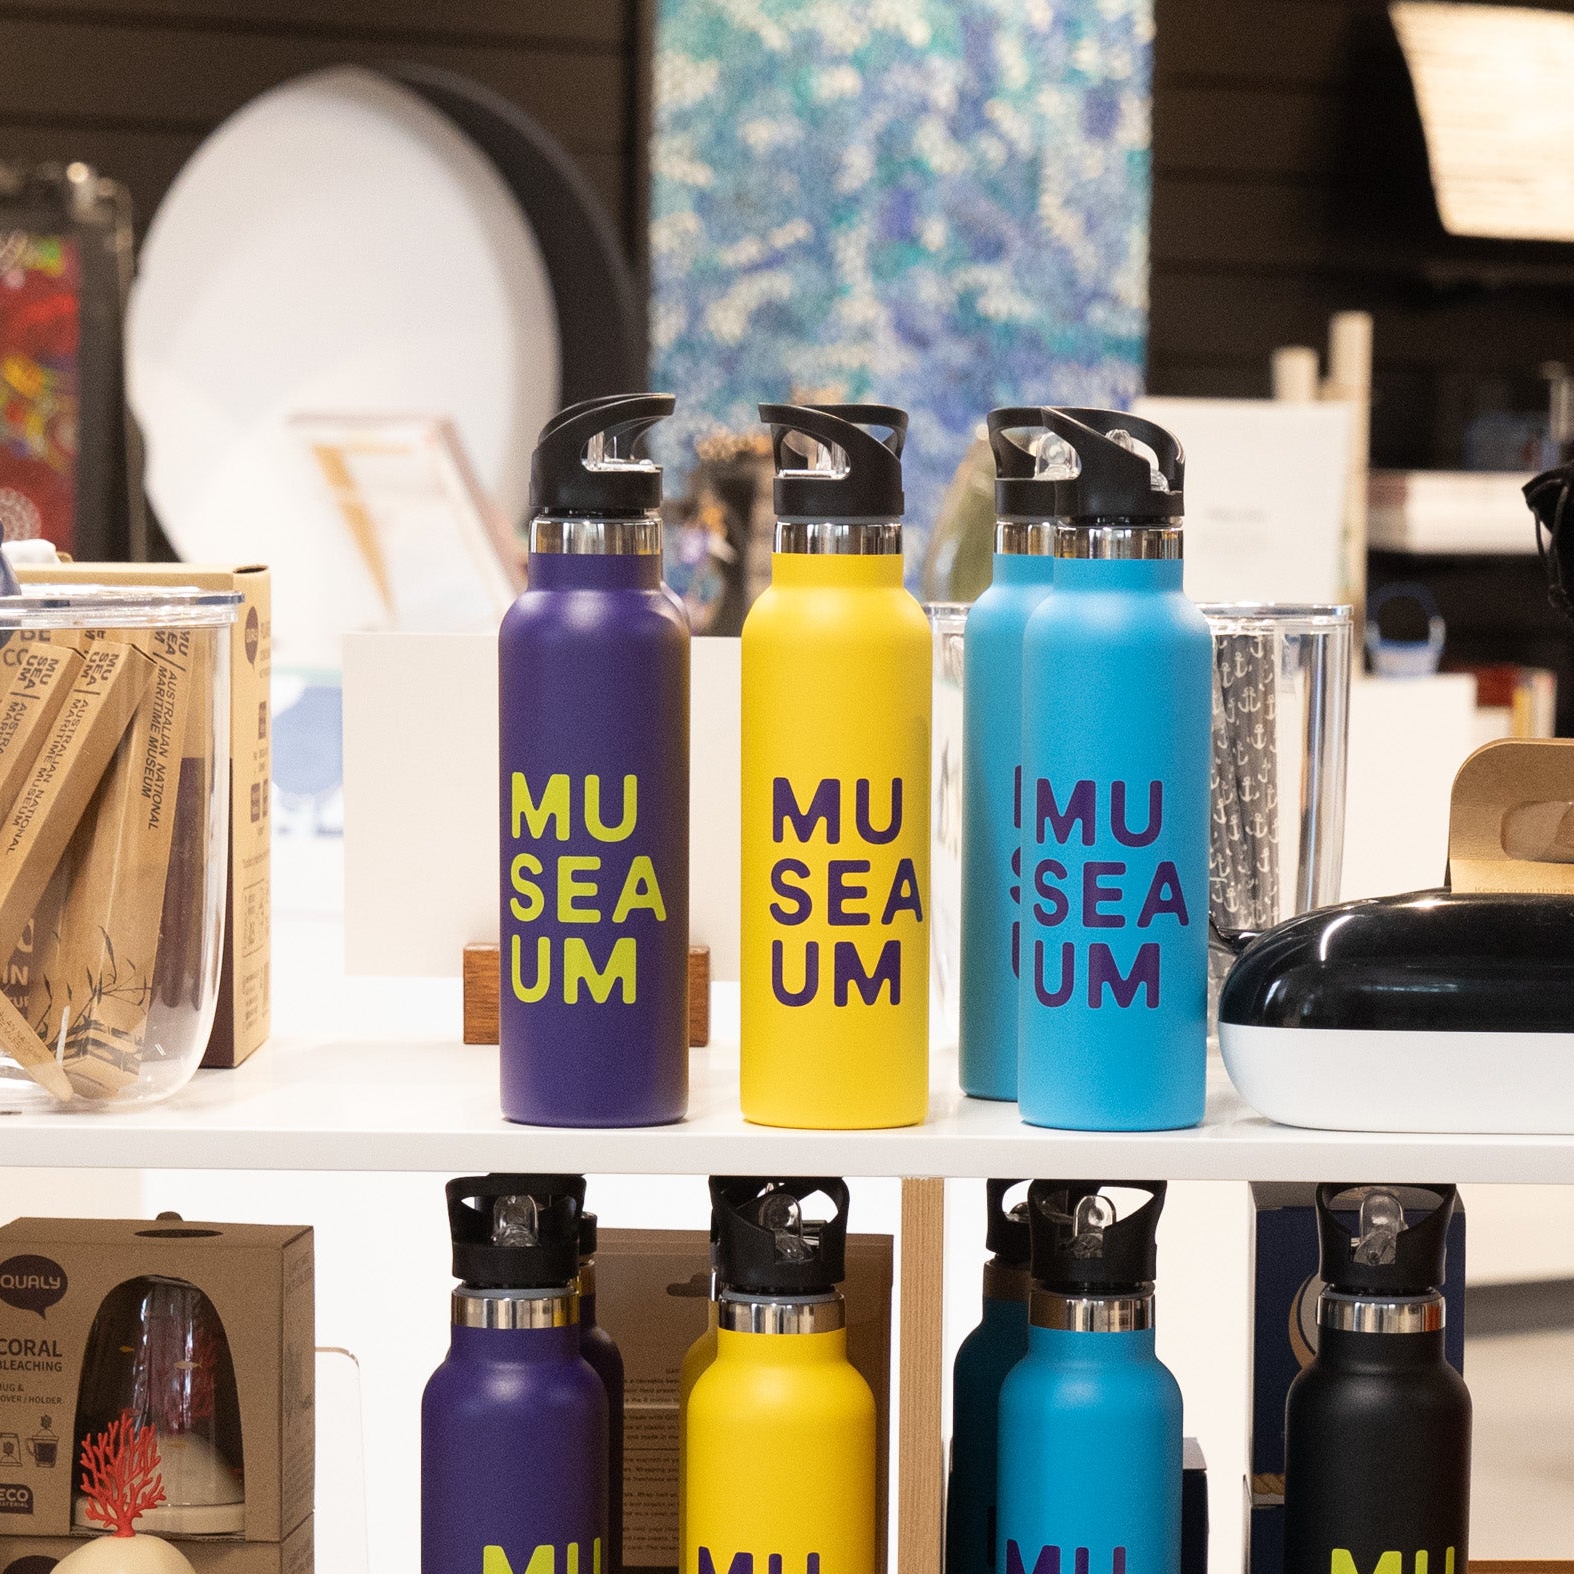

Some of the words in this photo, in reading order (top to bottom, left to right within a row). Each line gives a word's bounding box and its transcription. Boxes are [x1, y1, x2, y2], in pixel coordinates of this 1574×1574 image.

[18, 655, 37, 682] UM
[24, 656, 48, 689] SEA
[40, 658, 60, 686] MU
[151, 666, 167, 735] MARITIME
[160, 672, 178, 758] AUSTRALIAN
[141, 738, 160, 800] MUSEUM
[147, 765, 167, 831] NATIONAL
[511, 772, 638, 843] MU
[772, 777, 904, 846] MU
[1034, 779, 1163, 849] MU
[510, 852, 667, 923] SEA
[769, 858, 923, 927] SEA
[1032, 858, 1189, 928] SEA
[511, 935, 637, 1004] UM
[771, 939, 901, 1007] UM
[1034, 942, 1160, 1009] UM
